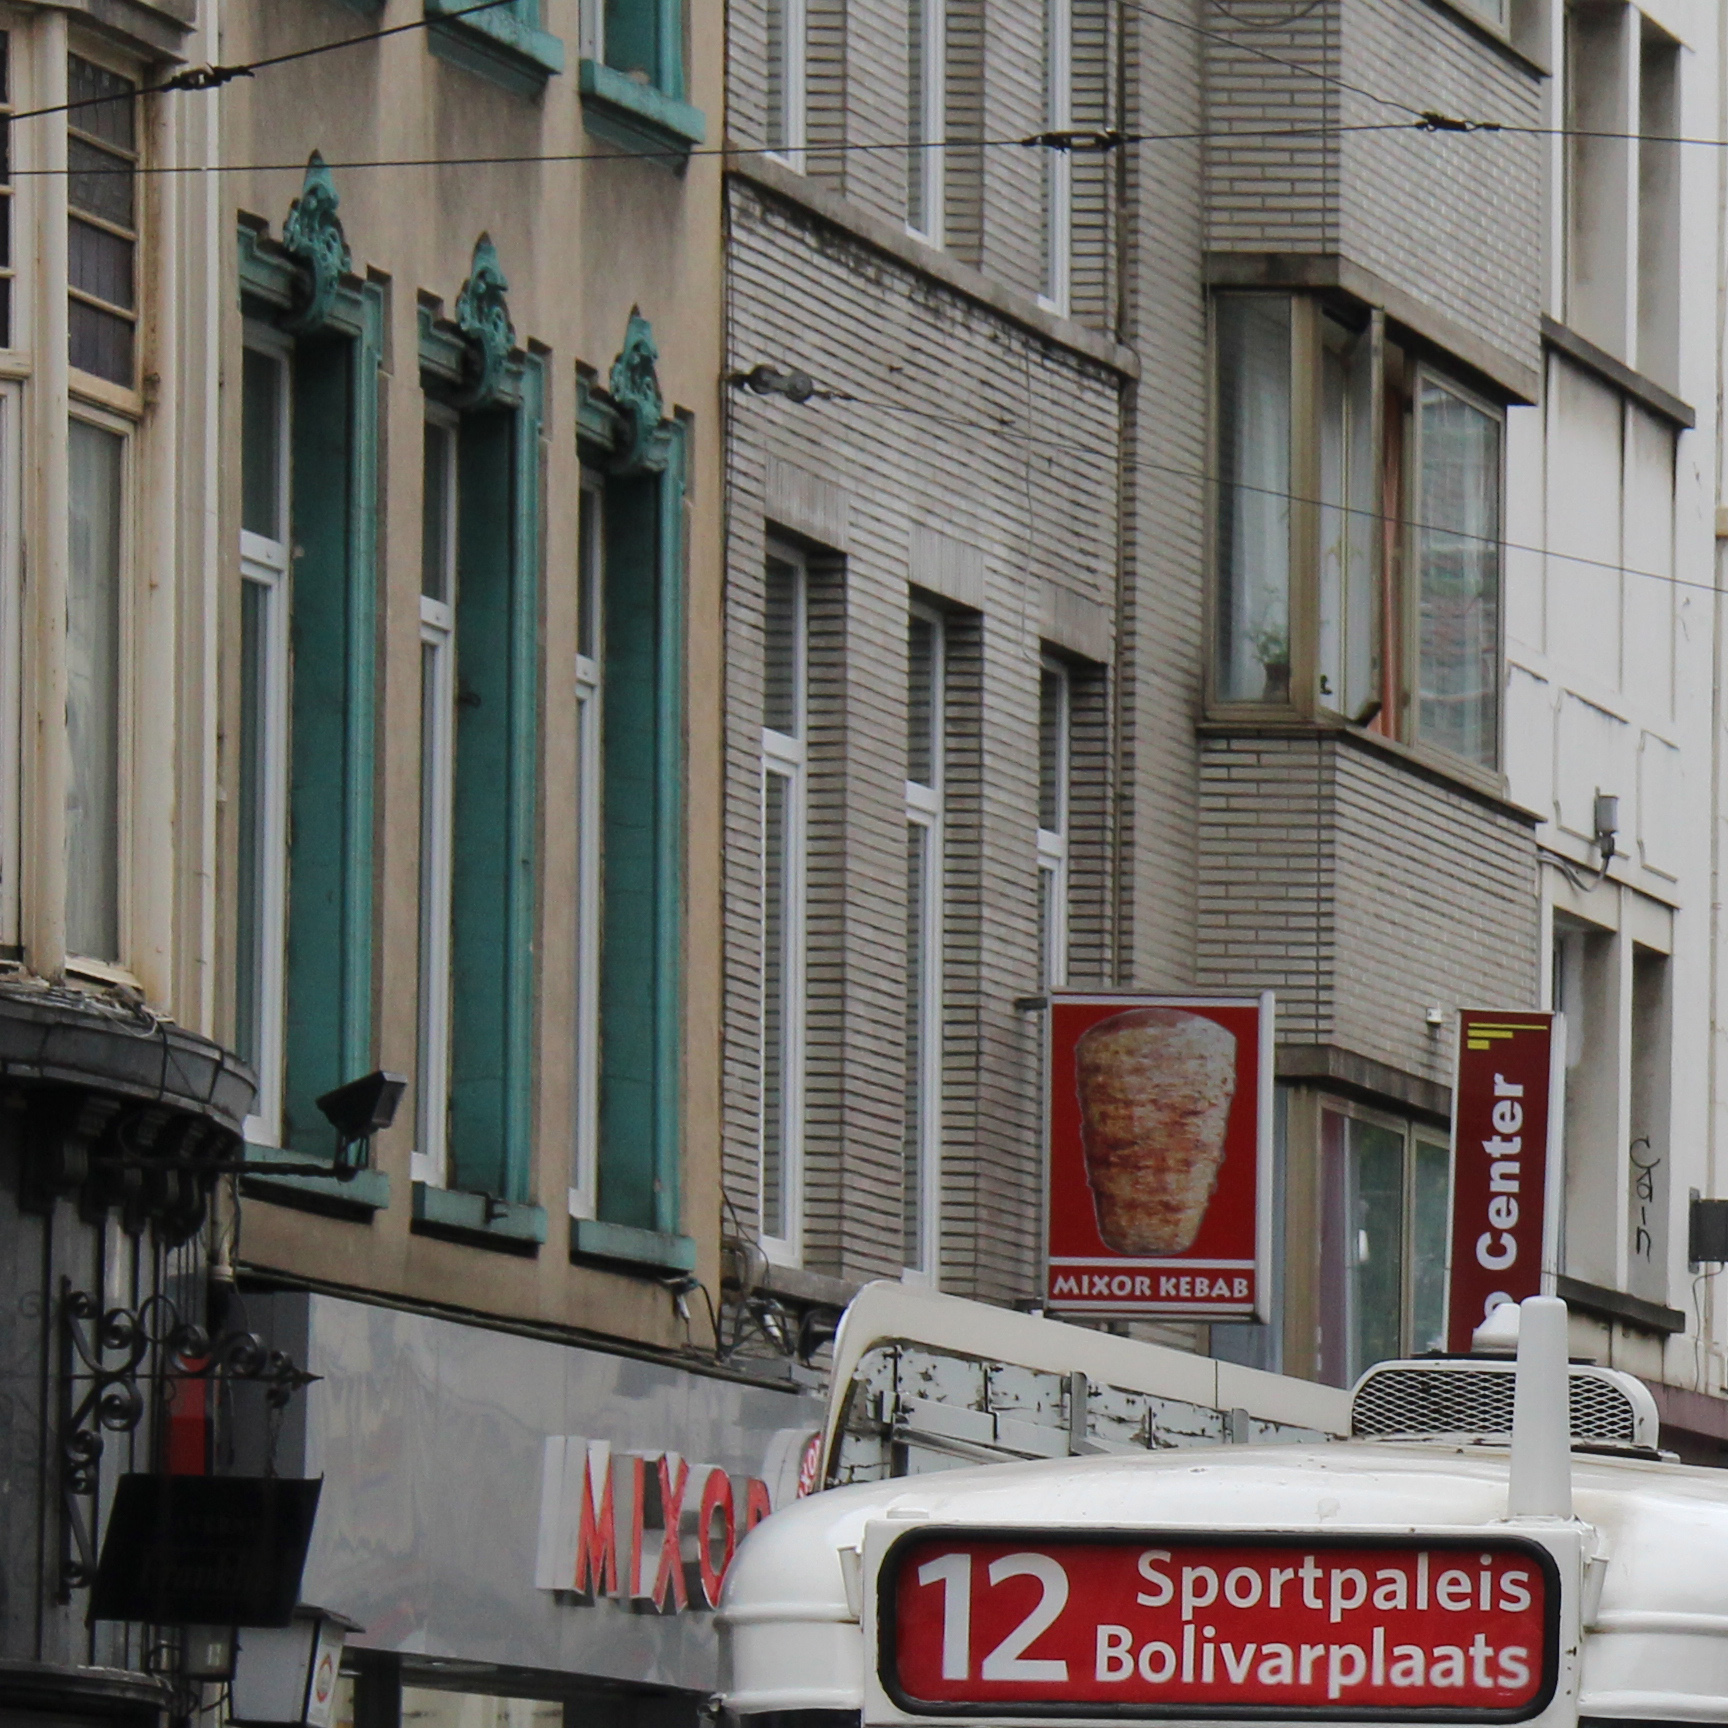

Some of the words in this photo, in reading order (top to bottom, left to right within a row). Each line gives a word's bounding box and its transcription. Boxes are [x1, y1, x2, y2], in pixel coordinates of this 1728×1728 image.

[1476, 1073, 1523, 1271] Center
[1053, 1275, 1151, 1296] MIXOR
[1160, 1276, 1248, 1298] KEBAB
[918, 1553, 1070, 1682] 12
[1137, 1550, 1531, 1621] Sportpaleis
[1094, 1624, 1530, 1698] Bolivarplaats
